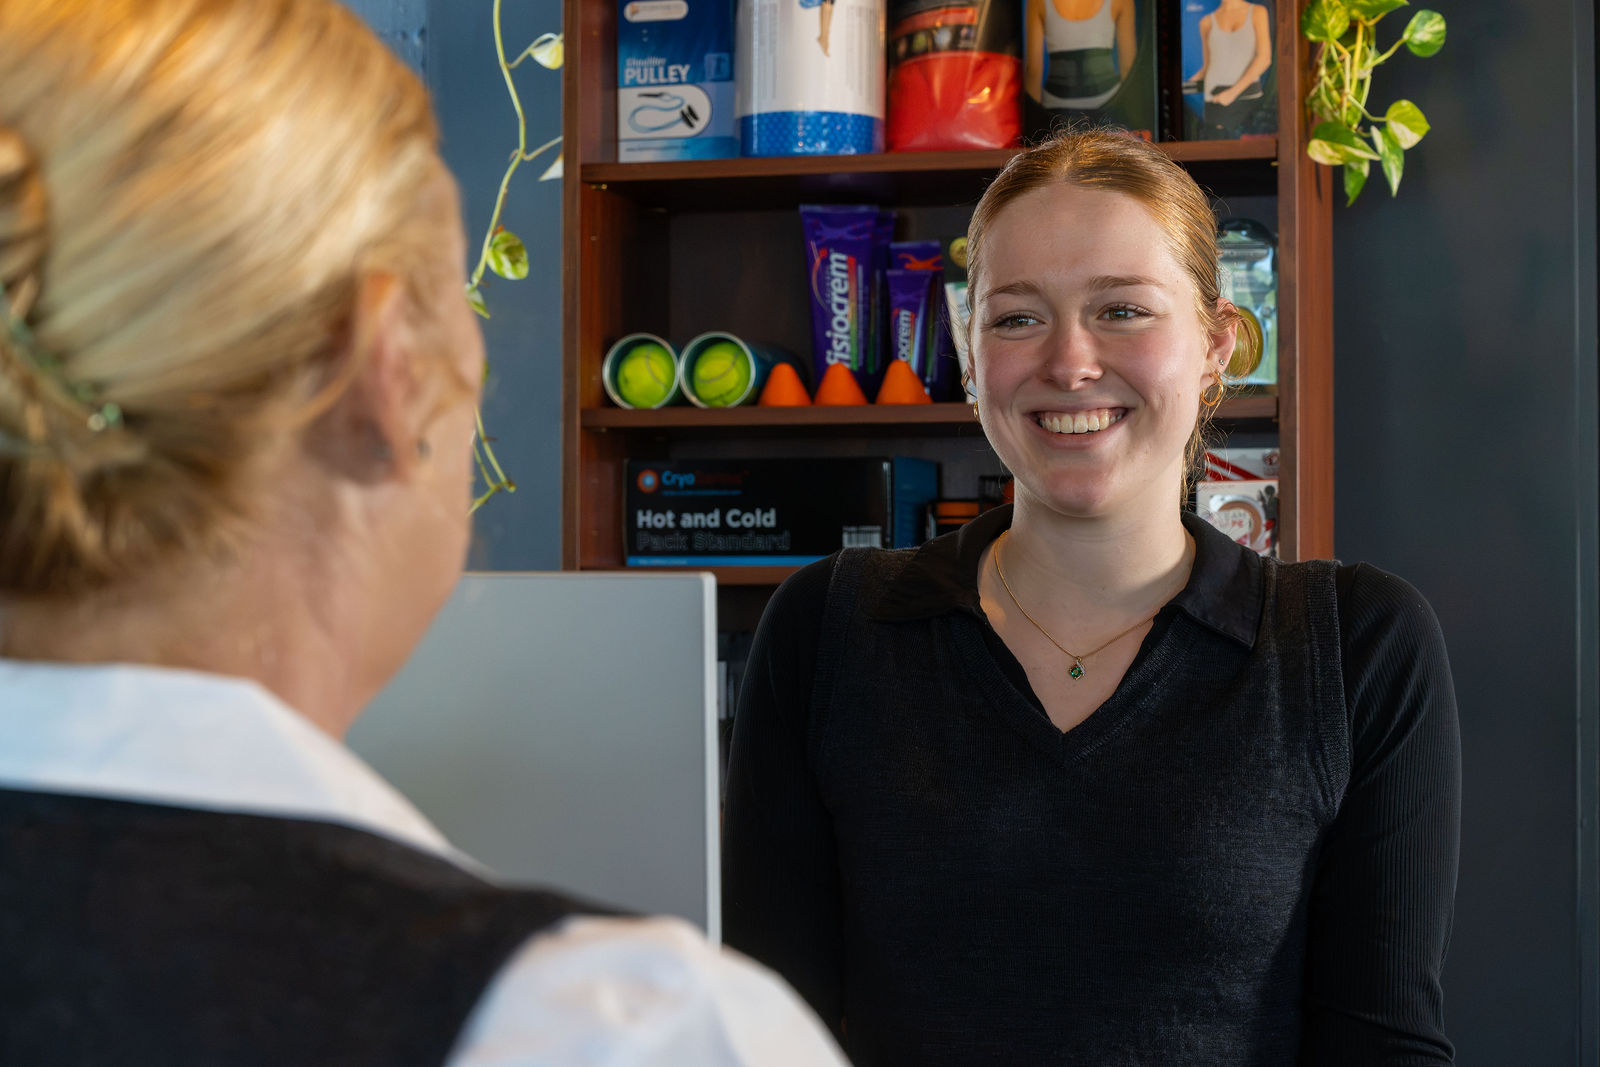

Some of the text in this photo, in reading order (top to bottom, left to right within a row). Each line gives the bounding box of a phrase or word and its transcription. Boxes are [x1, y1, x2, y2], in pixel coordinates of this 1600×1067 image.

[624, 64, 691, 85] PULLEY
[636, 507, 777, 529] Hot and Cold
[636, 529, 791, 552] Pack Standard
